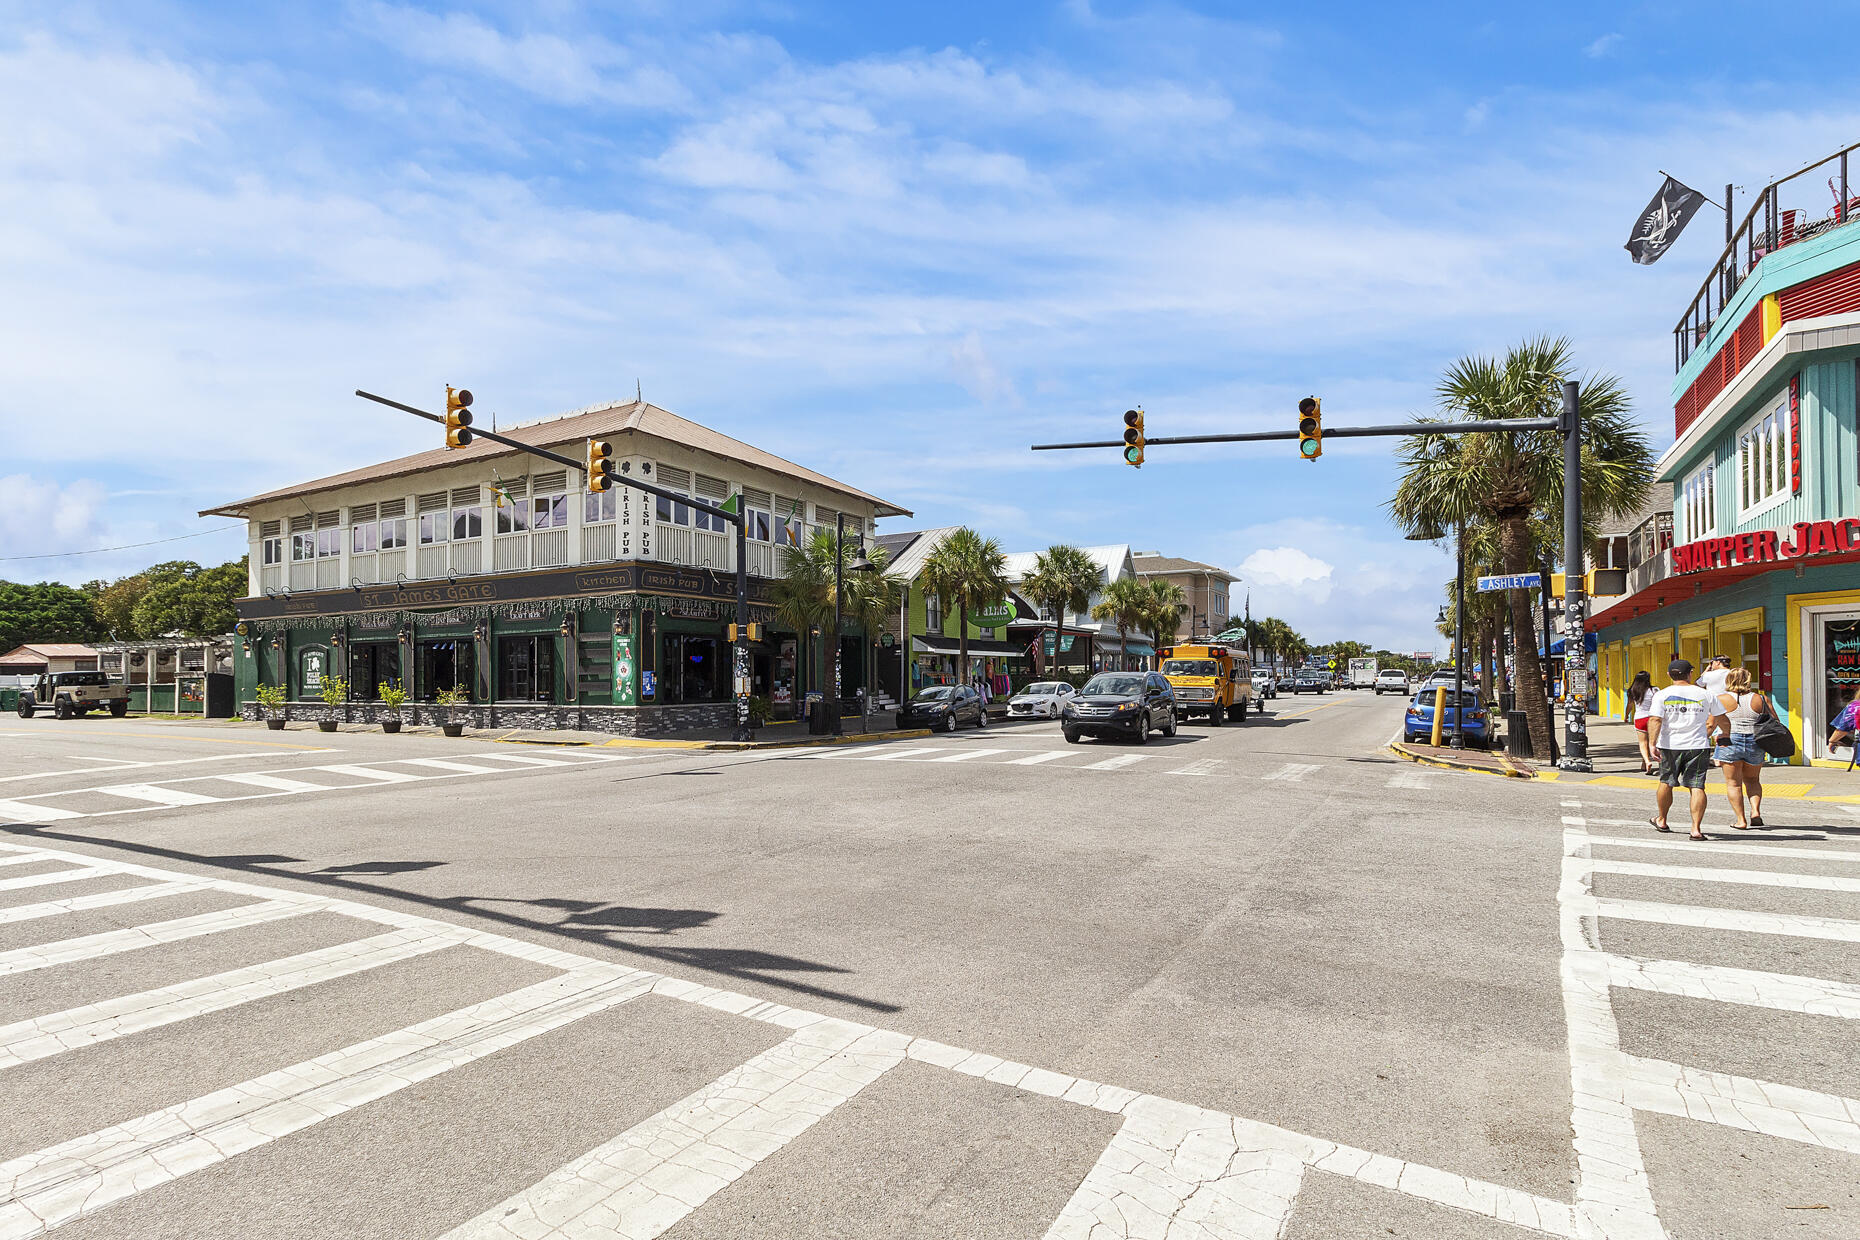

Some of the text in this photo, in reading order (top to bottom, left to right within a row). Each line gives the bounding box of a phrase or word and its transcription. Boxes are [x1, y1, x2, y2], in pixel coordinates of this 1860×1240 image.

[1790, 377, 1800, 492] SEAFOOD
[622, 487, 630, 555] IRISH PUB
[642, 532, 650, 555] PUB
[1672, 531, 1778, 573] SNAPPER
[392, 588, 441, 605] JAMES
[447, 584, 492, 600] GATE
[1488, 577, 1526, 590] ASHLEY
[1350, 662, 1374, 670] FedEx
[1837, 655, 1855, 665] RAW
